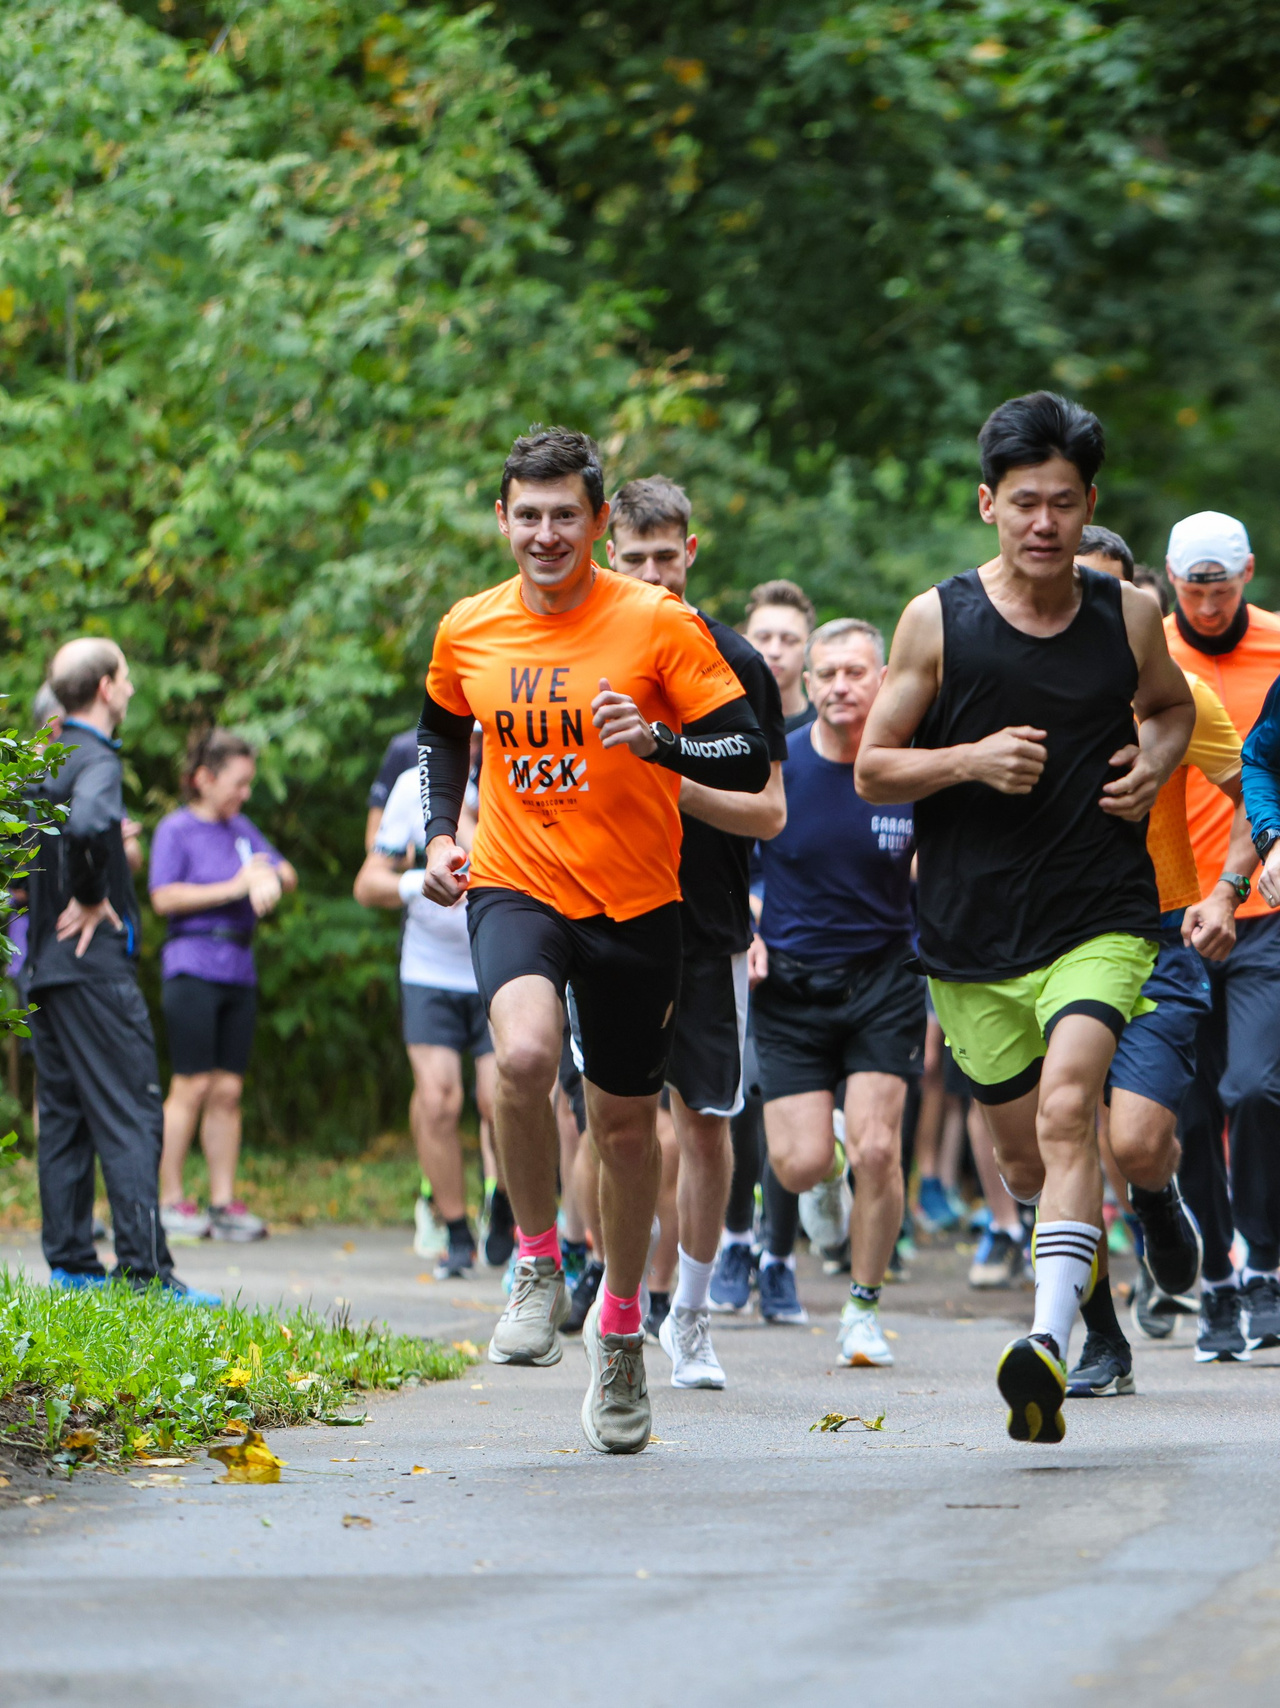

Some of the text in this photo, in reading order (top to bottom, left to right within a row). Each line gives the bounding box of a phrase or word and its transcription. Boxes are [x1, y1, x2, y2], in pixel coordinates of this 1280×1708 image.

[510, 667, 570, 704] WE
[495, 709, 584, 748] RUN
[680, 734, 751, 758] saucony
[511, 758, 578, 788] MSK
